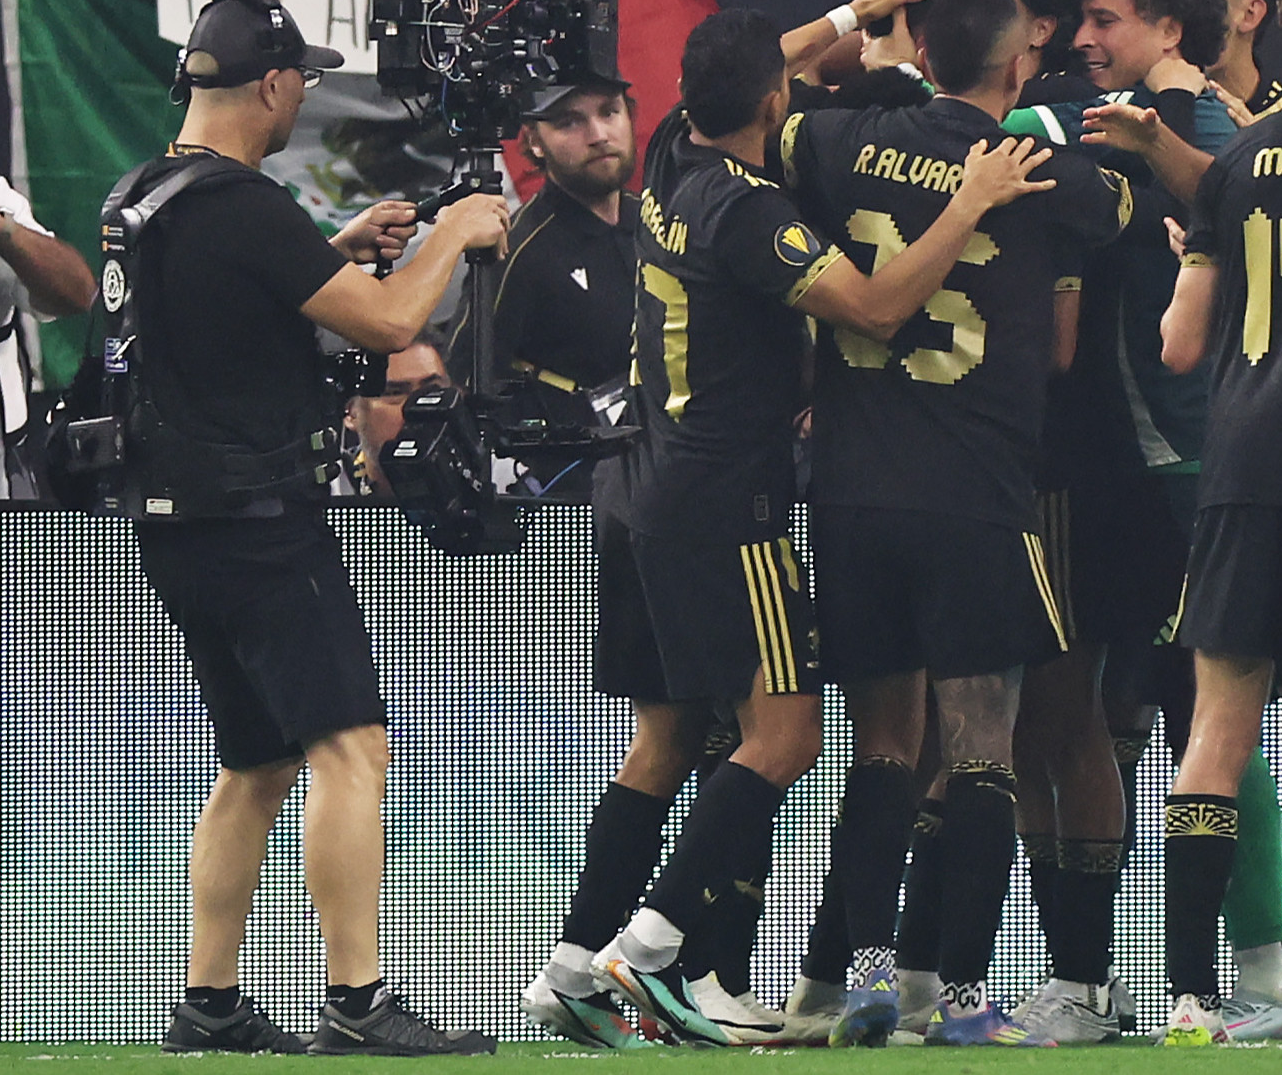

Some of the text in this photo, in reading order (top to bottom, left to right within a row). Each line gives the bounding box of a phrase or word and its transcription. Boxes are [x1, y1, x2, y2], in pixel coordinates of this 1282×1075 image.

[853, 143, 965, 196] R.ALVAR
[630, 259, 692, 423] 7
[833, 208, 1001, 386] 25
